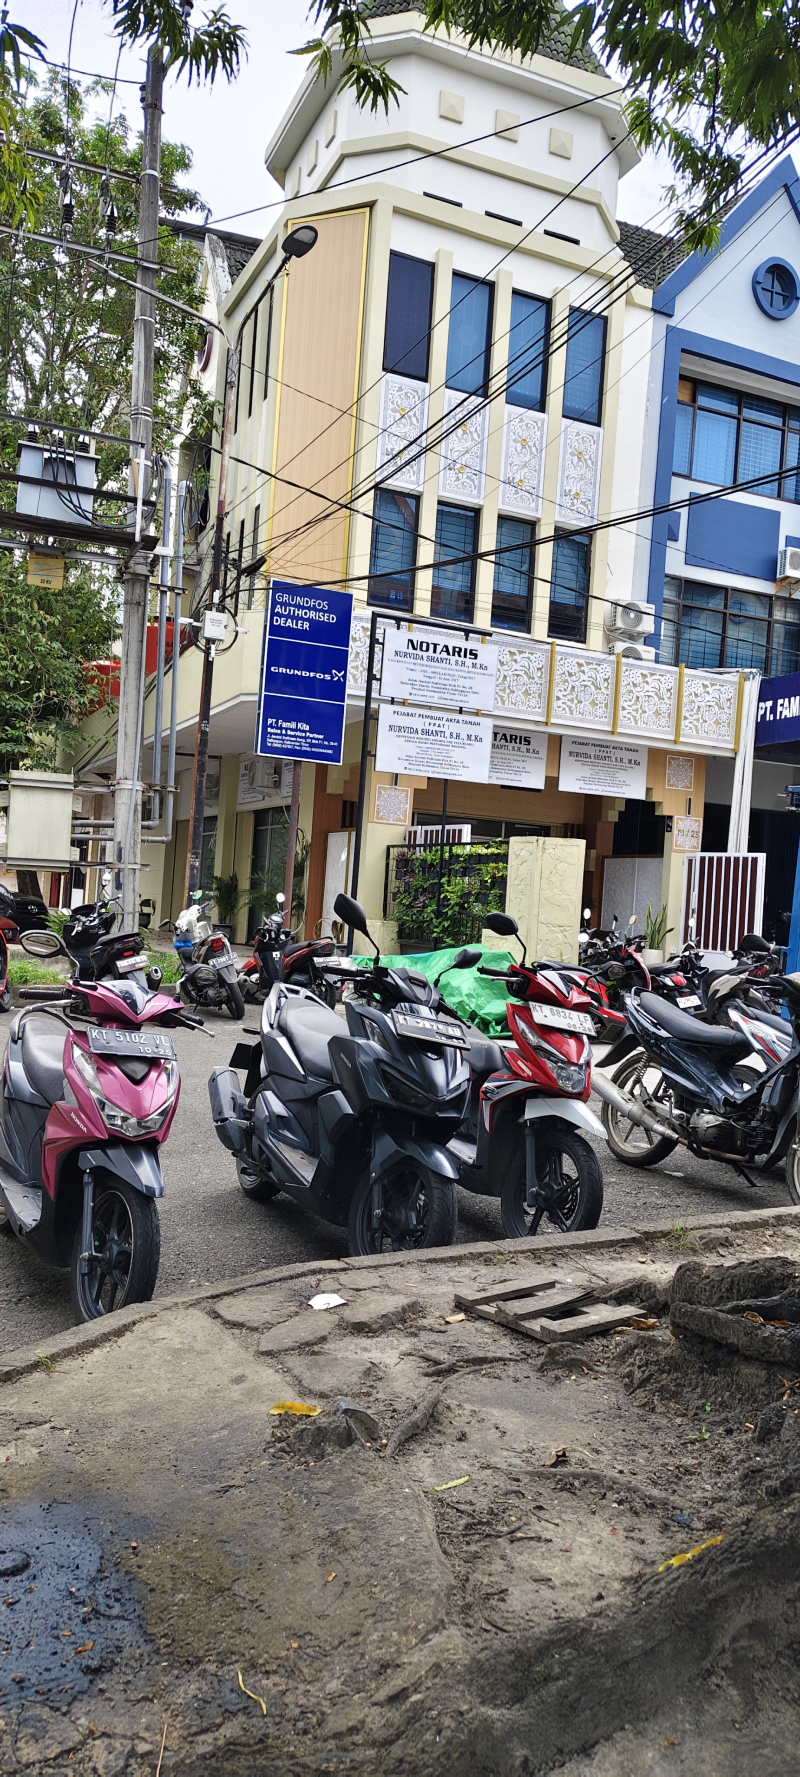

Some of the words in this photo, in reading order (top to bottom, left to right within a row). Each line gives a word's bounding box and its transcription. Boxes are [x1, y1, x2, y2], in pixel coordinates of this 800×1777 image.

[276, 593, 328, 610] GRUNDFOS
[274, 604, 336, 624] AUTHORISED
[273, 616, 310, 631] DEALER
[406, 638, 479, 660] NOTARIS
[394, 650, 424, 661] NURVIDA
[426, 655, 453, 666] SHANTI,
[472, 662, 488, 671] M.Kn
[271, 666, 332, 680] GRUNDFOS
[392, 710, 417, 718] PEJABAT
[758, 700, 774, 722] PT.
[776, 696, 800, 719] FAM
[267, 718, 276, 727] PT.
[297, 722, 310, 731] Kita
[388, 724, 418, 735] NURVIDA
[421, 728, 448, 740] SHANTI,
[466, 734, 483, 743] M.Kn
[568, 751, 591, 760] NURVIDA
[531, 1004, 543, 1014] KT
[550, 1008, 573, 1020] 6834
[577, 1014, 589, 1024] LF
[91, 1030, 107, 1040] KT
[115, 1032, 147, 1044] 5102
[154, 1035, 170, 1046] VL
[70, 1112, 87, 1133] HONDA
